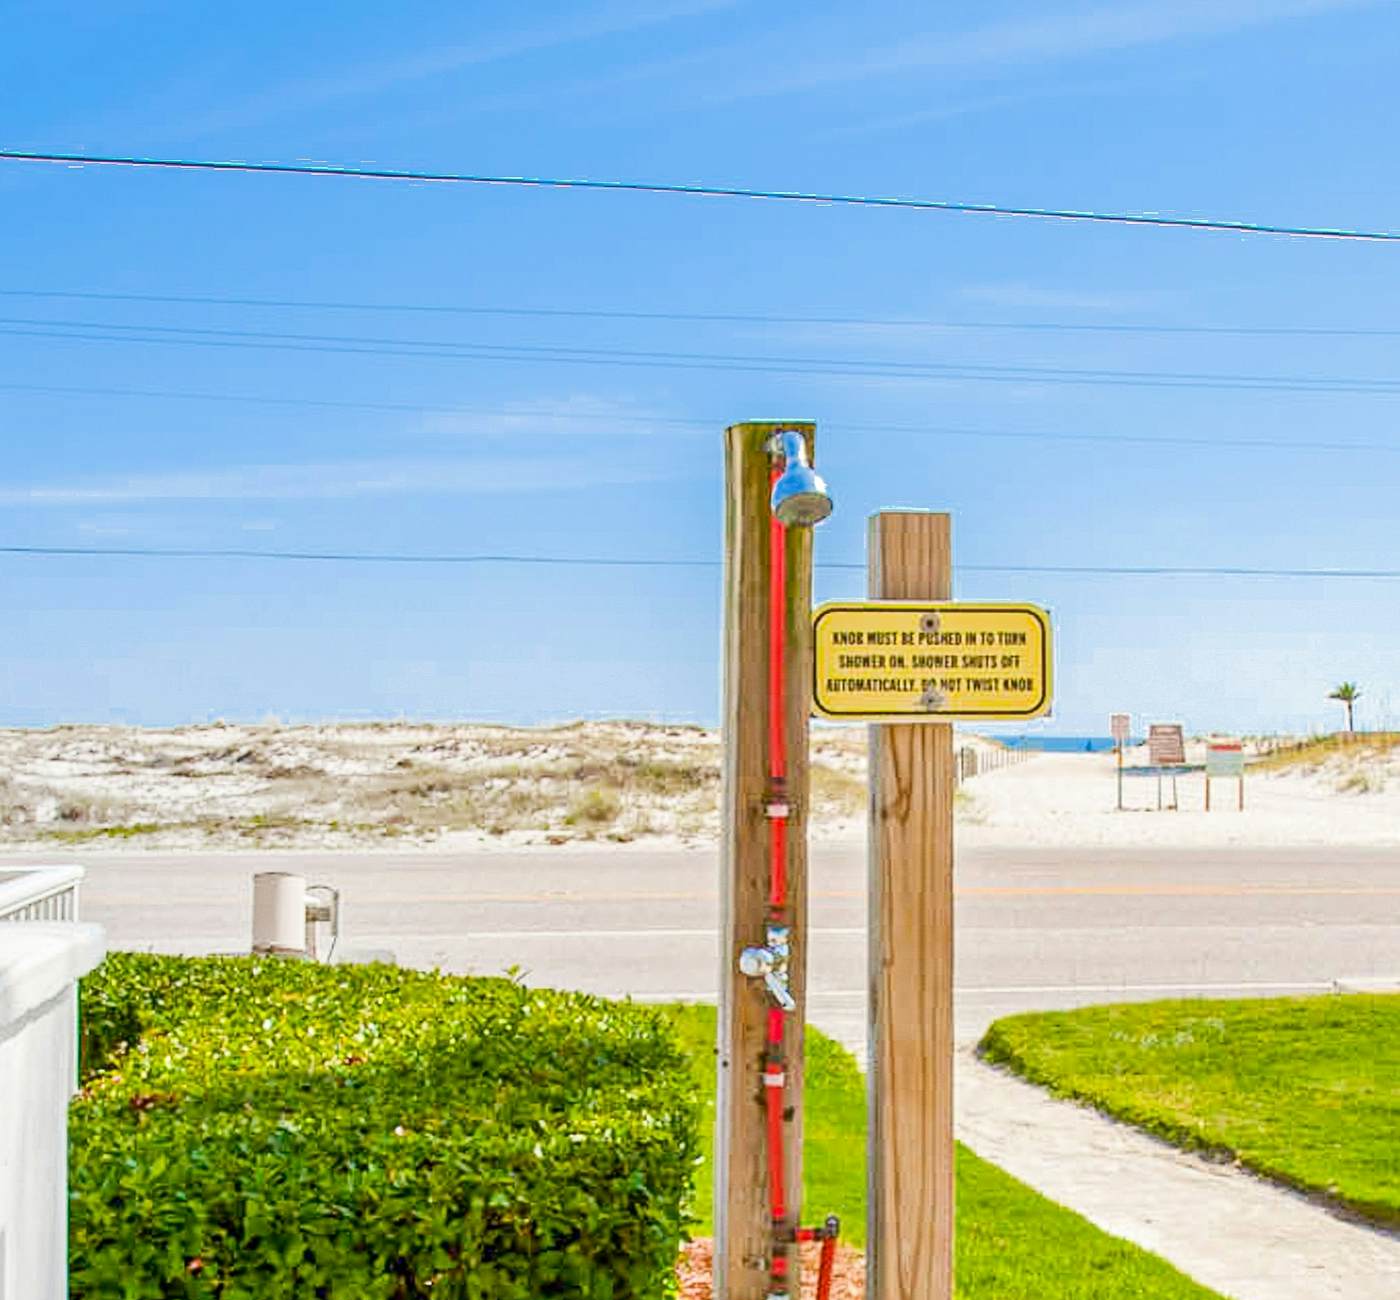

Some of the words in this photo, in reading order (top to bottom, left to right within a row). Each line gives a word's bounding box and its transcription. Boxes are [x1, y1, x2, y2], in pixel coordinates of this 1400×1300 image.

[833, 631, 863, 646] KNOB
[867, 631, 897, 646] MUST
[902, 631, 914, 646] BE
[919, 631, 962, 646] PUSHED
[965, 631, 977, 646] IN
[981, 631, 994, 646] TO
[998, 631, 1026, 646] TURN
[839, 655, 886, 669] SHOWER
[912, 655, 958, 669] SHOWER
[962, 655, 997, 669] SHUTS
[1001, 655, 1020, 669] OFF
[940, 678, 961, 692] NOT
[966, 678, 999, 692] TWIST
[1003, 678, 1033, 692] KNOB
